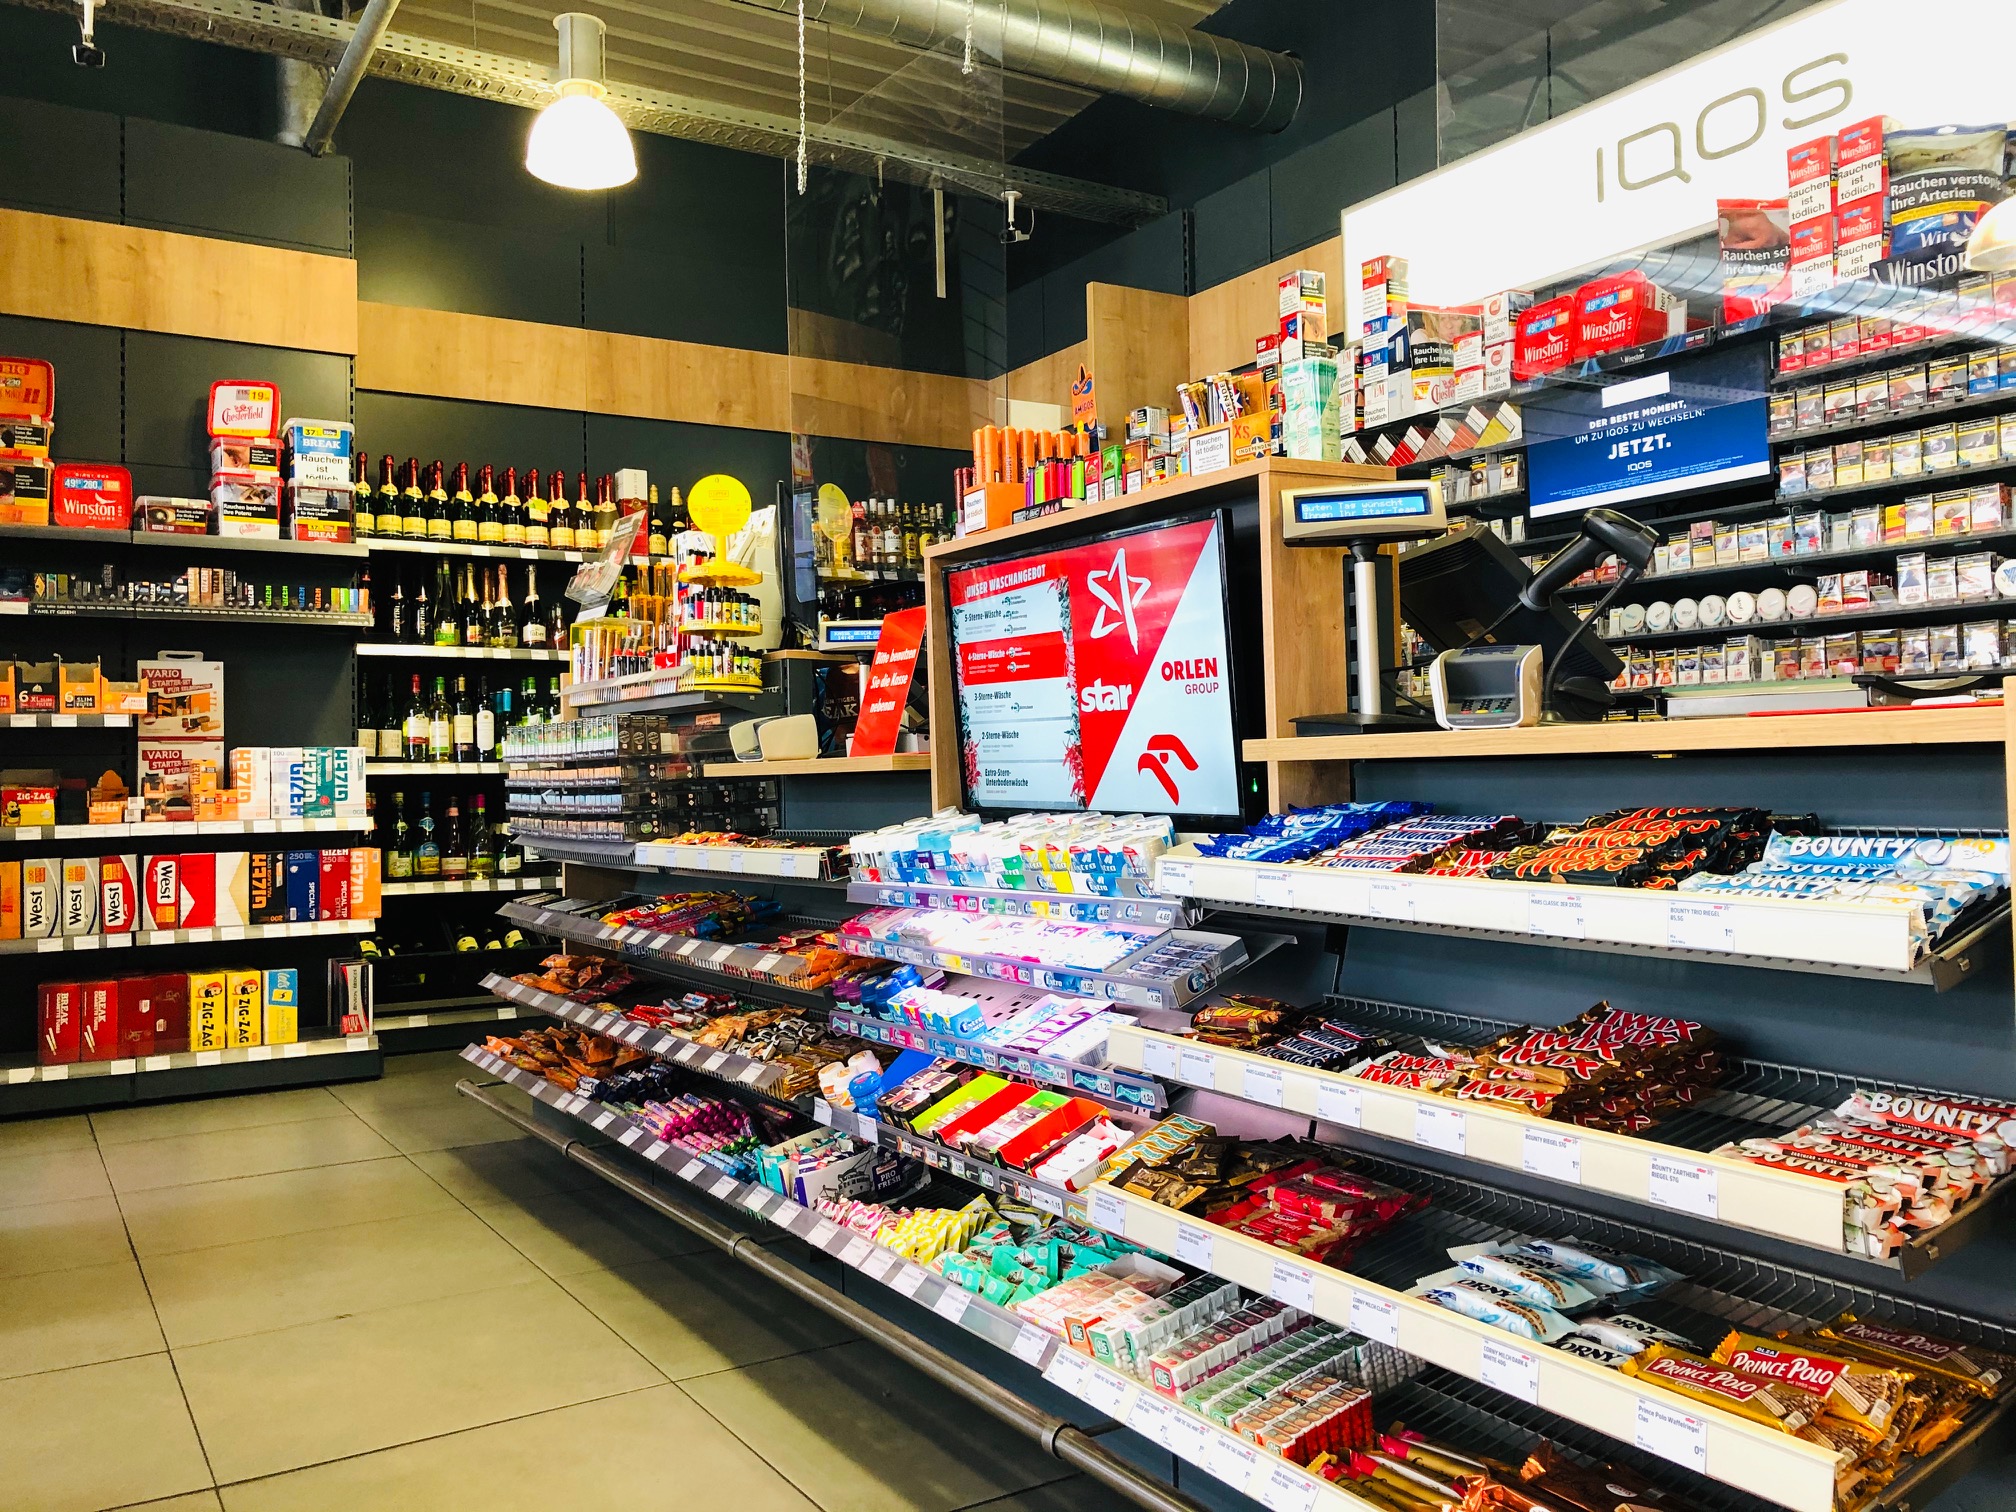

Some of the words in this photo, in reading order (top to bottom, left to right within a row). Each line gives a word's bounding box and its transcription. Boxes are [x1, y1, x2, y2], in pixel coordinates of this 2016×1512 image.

[1597, 52, 1852, 203] IQOS
[1841, 142, 1872, 160] Winston
[1790, 162, 1820, 181] Winston
[1838, 160, 1881, 180] Rauchen
[1789, 179, 1830, 200] Rauchen
[1851, 175, 1864, 186] ist
[1841, 181, 1875, 200] tödlich
[1891, 196, 1916, 211] Ihre
[1919, 188, 1976, 204] Arterien
[1801, 196, 1814, 206] ist
[1792, 203, 1825, 220] tödlich
[1841, 220, 1872, 238] Winston
[1793, 241, 1823, 258] Winston
[1838, 240, 1881, 259] Rauchen
[1851, 256, 1864, 265] ist
[1485, 315, 1508, 327] Rauchen
[1582, 317, 1626, 342] Winston
[1486, 331, 1505, 341] tödlich
[1523, 340, 1563, 365] Winston
[1486, 367, 1509, 377] Rauchen
[1488, 381, 1507, 392] tödlich
[222, 404, 263, 426] Chesterfield
[1074, 398, 1094, 417] AMIGOS
[1365, 406, 1386, 416] Rauchen
[1589, 417, 1608, 430] DER
[1610, 411, 1640, 425] BESTE
[1641, 399, 1688, 417] MOMENT,
[1234, 425, 1250, 439] XS
[1575, 435, 1589, 445] UM
[1591, 431, 1604, 442] ZU
[1606, 424, 1629, 440] IQOS
[1632, 422, 1645, 433] ZU
[1647, 408, 1706, 428] WECHSELN:
[302, 438, 341, 449] BREAK
[1196, 434, 1222, 446] Rauchen
[1203, 442, 1224, 454] tödlich
[1607, 433, 1672, 461] JETZT.
[301, 453, 343, 465] Rauchen
[1627, 460, 1653, 473] IQOS
[316, 465, 328, 473] ist
[64, 497, 116, 516] Winston
[223, 503, 246, 511] Rauchen
[246, 504, 267, 512] bedroht
[1302, 503, 1333, 513] Guten
[1338, 501, 1356, 511] Tag
[1303, 511, 1334, 519] Ihnen
[1340, 510, 1356, 518] Ihr
[1362, 506, 1417, 516] Star-Team
[308, 531, 338, 539] BREAK
[966, 581, 988, 598] UNSER
[988, 563, 1047, 592] WASCHANGEBOT
[964, 608, 1002, 623] 5-Sterne-Wäsche
[875, 651, 889, 665] Bitte
[889, 648, 917, 664] benutzen
[967, 649, 1006, 662] 4-Sterne-Wäsche
[147, 669, 180, 679] VARIO
[1161, 657, 1218, 682] ORLEN
[151, 679, 192, 688] STARTER-SET
[167, 685, 181, 694] FÜR
[870, 676, 881, 690] Sie
[880, 673, 890, 688] die
[890, 673, 908, 687] Kasse
[1184, 682, 1219, 695] GROUP
[64, 691, 74, 703] 6
[974, 690, 1012, 701] 3-Sterne-Wäsche
[1081, 677, 1132, 713] star
[869, 697, 896, 714] nebenan
[981, 730, 1020, 740] 2-Sterne-Wäsche
[148, 750, 180, 759] VARIO
[237, 749, 251, 804] GIZEH
[303, 749, 317, 803] GIZEH
[334, 749, 348, 802] GIZEH
[984, 768, 1012, 777] Extra-Stern-
[290, 763, 304, 816] GIZEH
[985, 778, 1029, 787] Unterbodenwäsche
[16, 792, 52, 801] ZIG-ZAG
[1565, 826, 1680, 850] Mars
[1789, 836, 1917, 859] BOUNTY
[160, 864, 173, 900] West
[252, 853, 267, 909] GIZEH
[350, 850, 364, 905] GIZEH
[1708, 874, 1836, 893] BOUNTY
[30, 890, 43, 928] West
[69, 888, 82, 926] West
[108, 886, 120, 923] West
[1543, 899, 1560, 907] CLASSIC
[1670, 907, 1690, 915] BOUNTY
[1691, 908, 1702, 916] TRIO
[1703, 909, 1720, 918] RIEGEL
[61, 992, 69, 1025] BREAK
[202, 1001, 214, 1047] ZIG-ZAG
[239, 998, 250, 1044] ZIG-ZAG
[1603, 1007, 1702, 1042] TWIX
[1522, 1028, 1624, 1061] TWIX
[1388, 1052, 1457, 1072] TWIX
[1498, 1044, 1601, 1080] TWIX
[1359, 1063, 1424, 1089] TWIX
[1457, 1079, 1557, 1111] TWIX
[1869, 1092, 2000, 1135] BOUNTY
[1525, 1133, 1542, 1143] BOUNTY
[1542, 1136, 1558, 1147] RIEGEL
[880, 1168, 897, 1182] PRO
[1651, 1163, 1673, 1174] BOUNTY
[1673, 1167, 1700, 1180] ZARTHERB
[1651, 1171, 1669, 1182] RIEGEL
[1669, 1175, 1679, 1184] 57G
[878, 1174, 902, 1192] FRESH
[1352, 1296, 1365, 1306] CORNY
[1365, 1301, 1376, 1309] MILCH
[1844, 1323, 1906, 1343] PRINCE
[1902, 1335, 1950, 1354] POLO
[1483, 1352, 1497, 1363] WHITE
[1484, 1345, 1497, 1356] CORNY
[1497, 1349, 1511, 1359] MILCH
[1511, 1355, 1524, 1365] DARK
[1755, 1346, 1776, 1356] OLZA
[1653, 1359, 1714, 1382] PRINCE
[1711, 1371, 1757, 1393] POLO
[1733, 1352, 1787, 1378] PRINCE
[1786, 1357, 1835, 1386] POLO
[1674, 1380, 1709, 1394] CLASSIC
[1638, 1413, 1649, 1423] Clas
[1638, 1404, 1655, 1417] Prince
[1655, 1411, 1667, 1421] Polo
[1667, 1415, 1700, 1434] Waffelriegel
